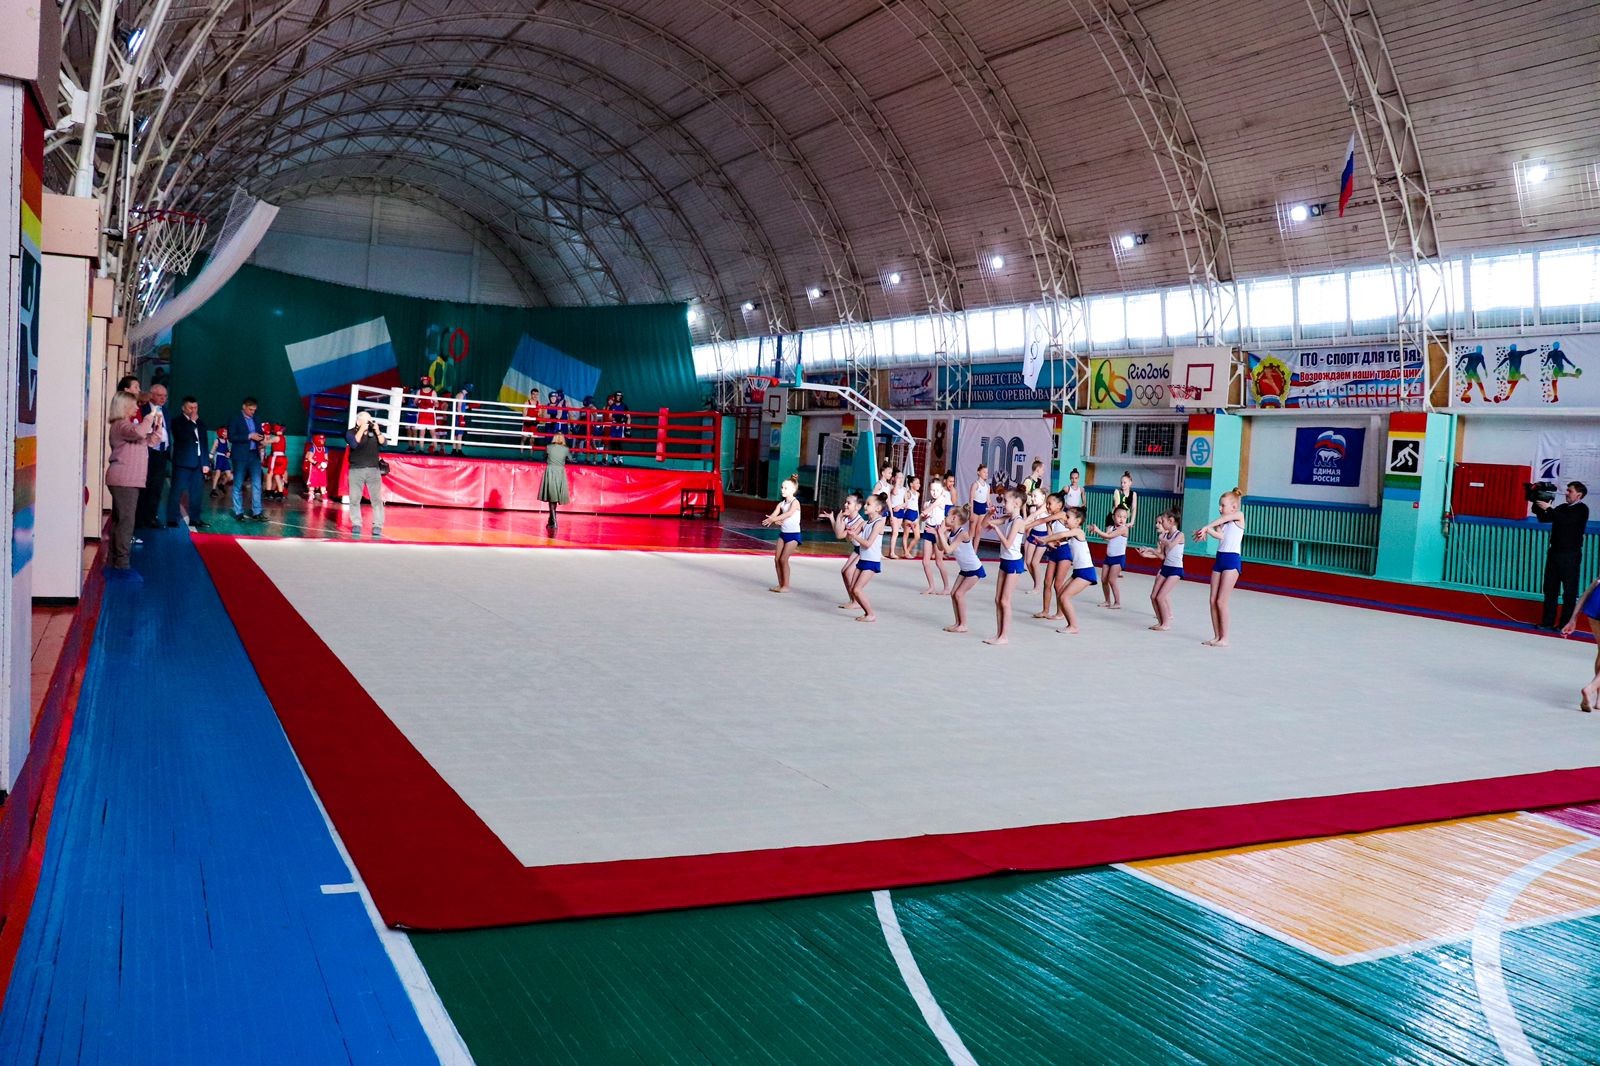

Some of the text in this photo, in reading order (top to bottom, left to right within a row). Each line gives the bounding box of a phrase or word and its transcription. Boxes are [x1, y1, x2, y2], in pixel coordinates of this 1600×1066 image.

[1300, 352, 1317, 366] ГТО
[1326, 352, 1359, 366] спорт
[1361, 351, 1384, 365] для
[1386, 347, 1421, 362] тебя!
[1300, 370, 1350, 381] Возрождаем
[1352, 370, 1375, 380] наши
[1014, 454, 1026, 463] ЛЕТ
[1312, 467, 1341, 475] ЕДИНАЯ
[1312, 475, 1341, 483] РОССИЯ
